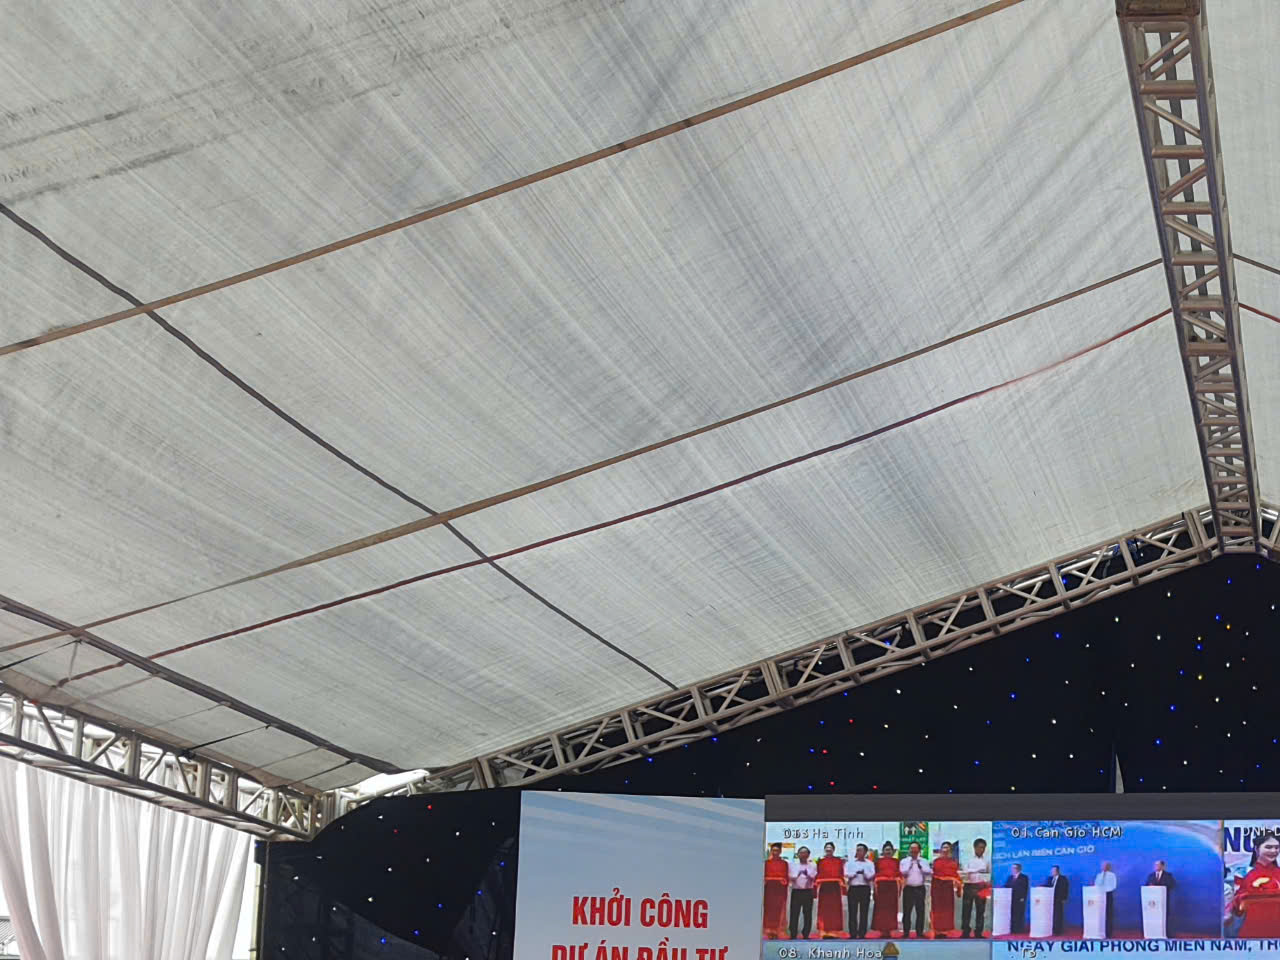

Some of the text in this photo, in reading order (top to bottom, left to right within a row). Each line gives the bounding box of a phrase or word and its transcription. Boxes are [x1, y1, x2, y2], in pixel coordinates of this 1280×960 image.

[573, 888, 708, 928] KHỞI CÔNG
[808, 947, 850, 959] Khanh
